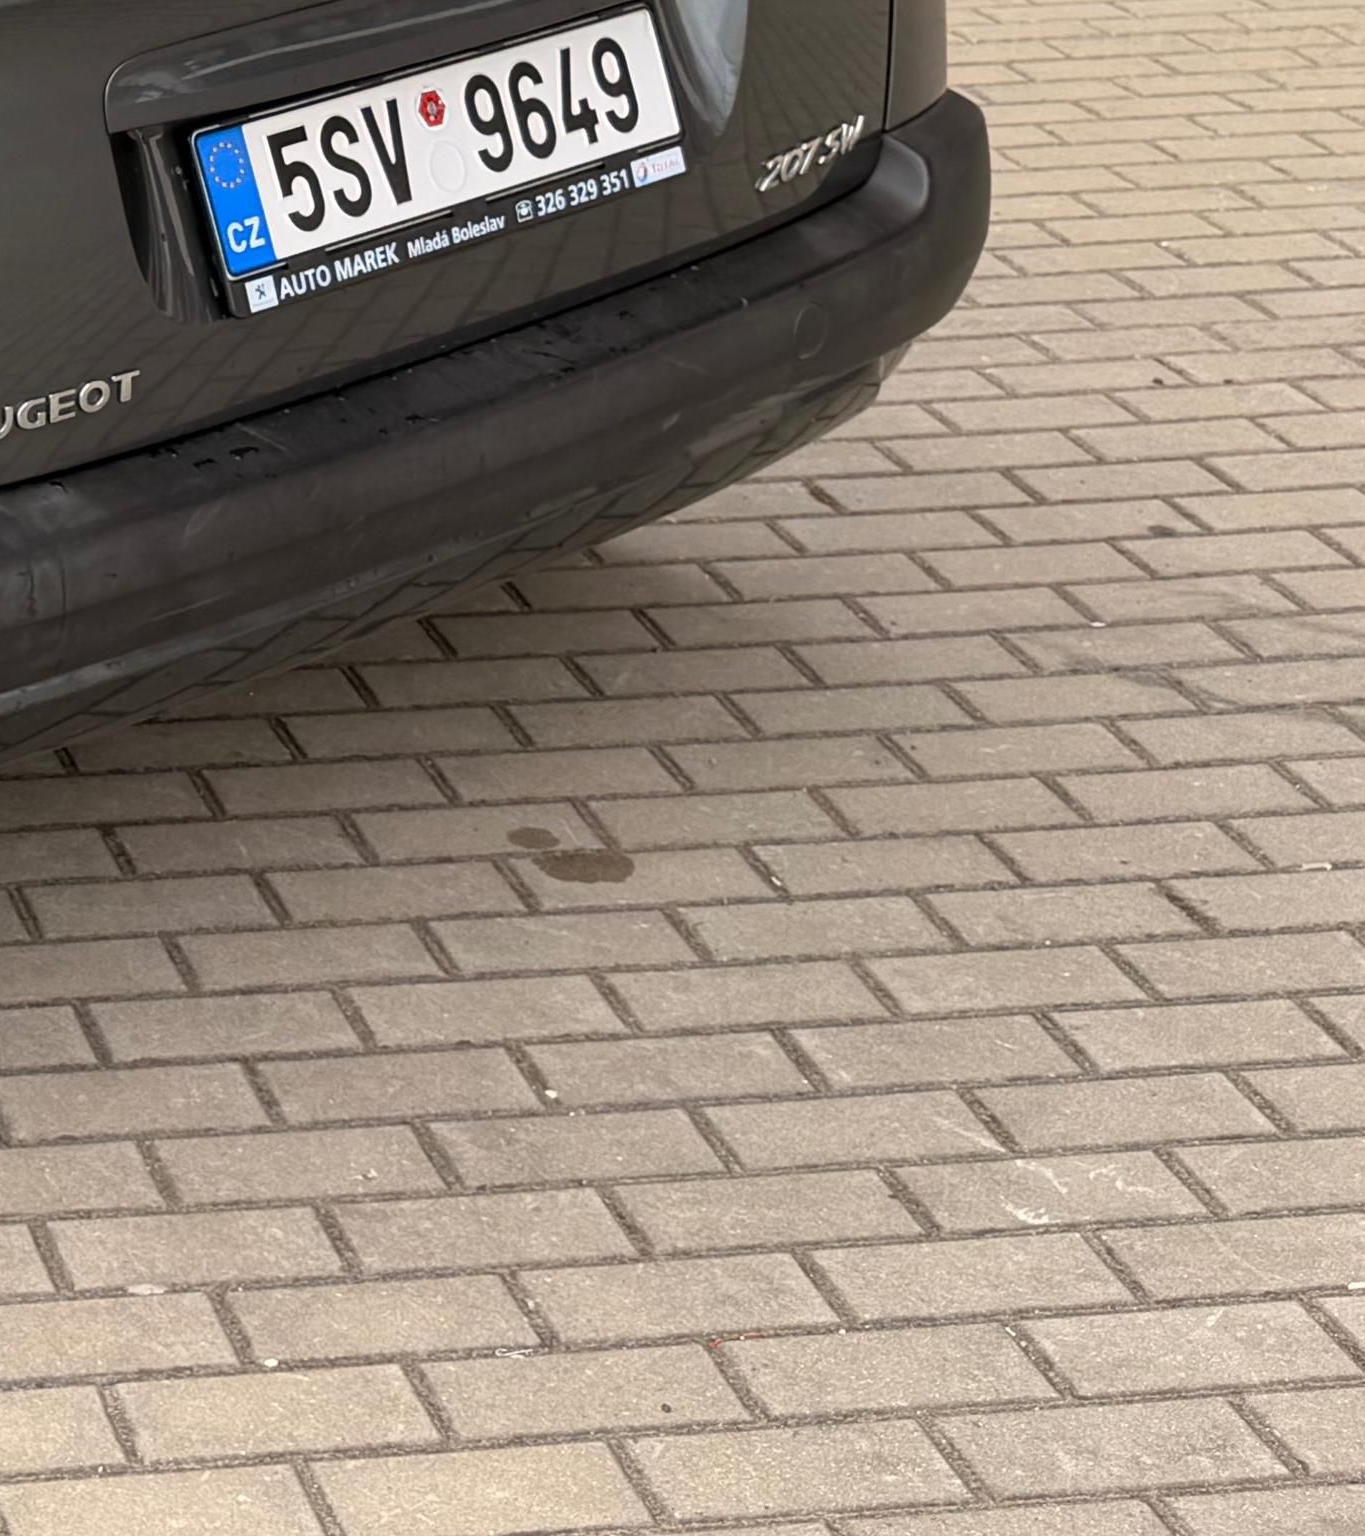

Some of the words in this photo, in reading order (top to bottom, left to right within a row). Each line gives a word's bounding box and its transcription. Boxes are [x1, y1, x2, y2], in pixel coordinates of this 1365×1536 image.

[267, 98, 414, 232] 5SV
[464, 37, 639, 172] 9649
[755, 136, 823, 191] 207
[227, 215, 266, 254] CZ
[280, 267, 331, 300] AUTO
[334, 242, 399, 283] MAREK
[407, 230, 450, 258] Mladá
[451, 215, 505, 244] Boleslav
[535, 189, 566, 217] 326
[568, 178, 598, 206] 329
[600, 168, 630, 196] 351
